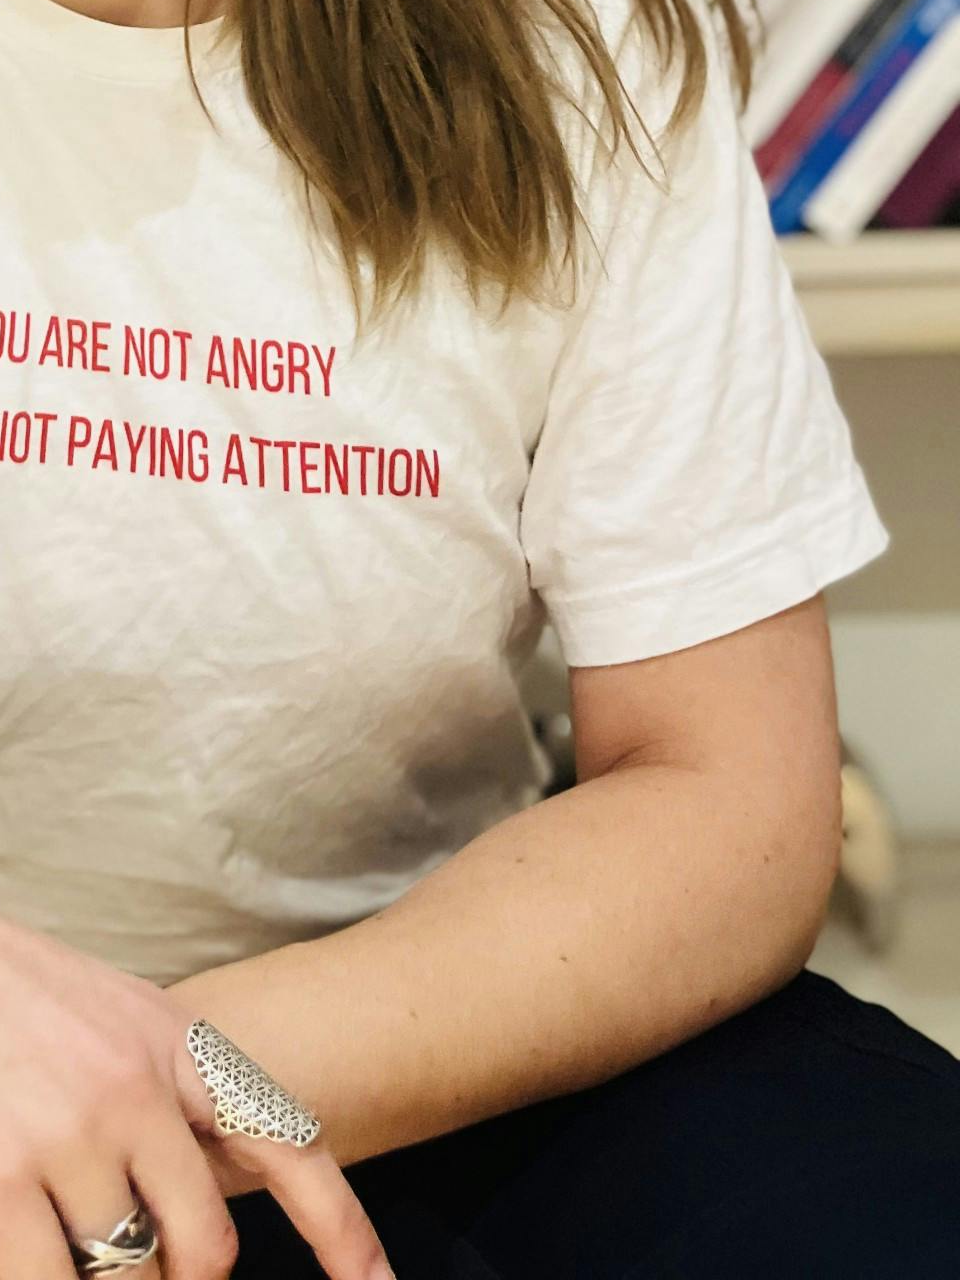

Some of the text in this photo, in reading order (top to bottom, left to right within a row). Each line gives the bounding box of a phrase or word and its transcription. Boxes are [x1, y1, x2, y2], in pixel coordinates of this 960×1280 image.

[38, 314, 112, 375] ARE
[123, 325, 193, 382] NOT
[206, 334, 337, 398] ANGRY
[67, 415, 210, 485] PAYING
[223, 433, 441, 499] ATTENTION
